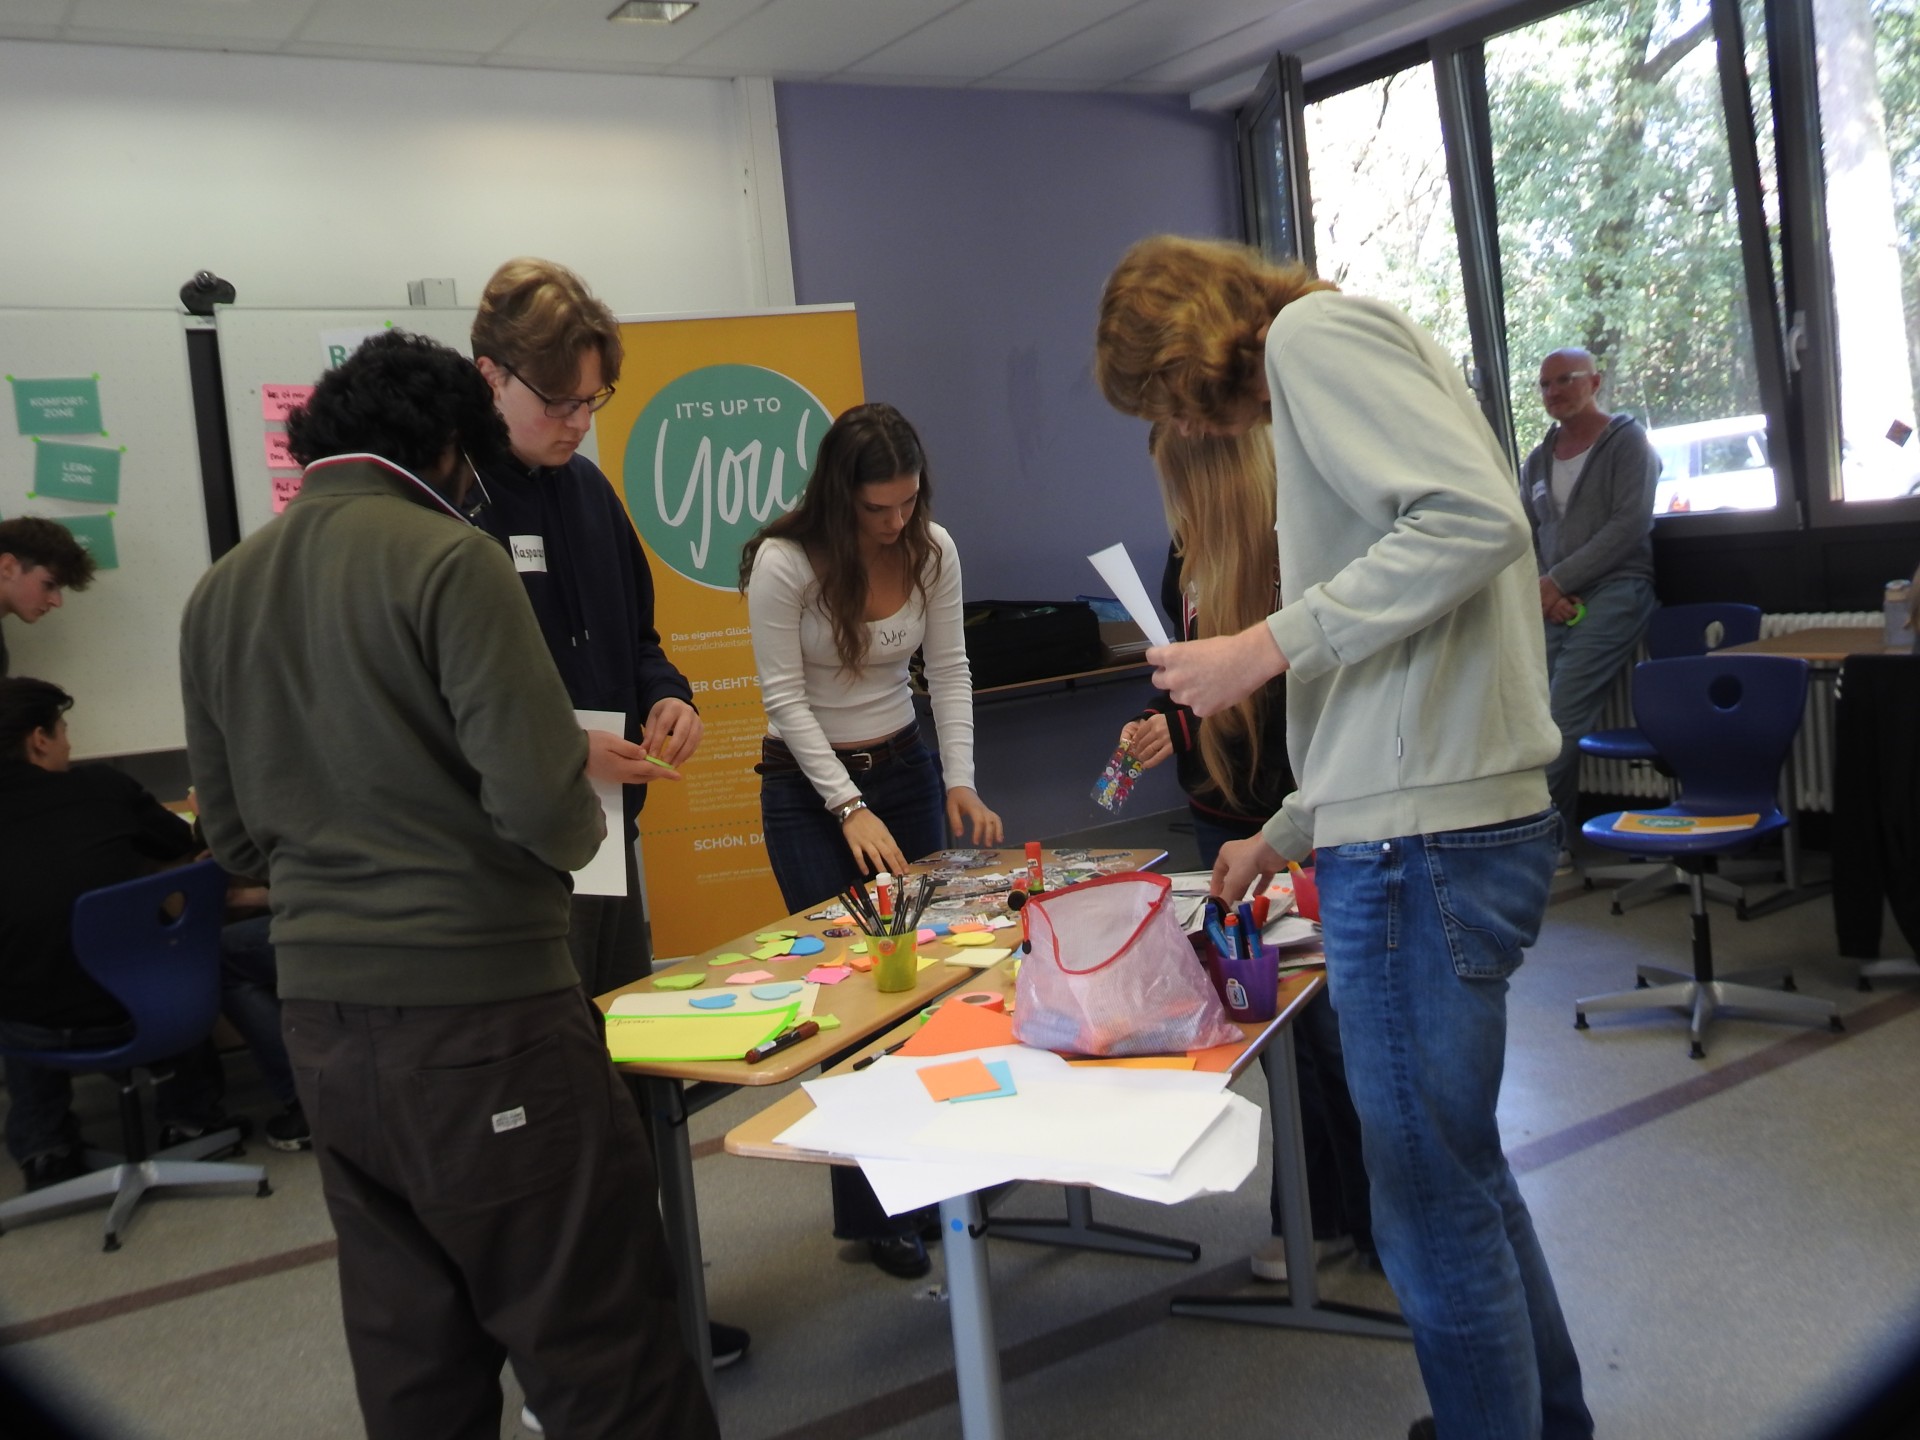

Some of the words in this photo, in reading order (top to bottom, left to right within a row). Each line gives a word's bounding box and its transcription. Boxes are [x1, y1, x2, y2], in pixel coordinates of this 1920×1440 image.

[29, 396, 88, 408] KOMFORT-
[676, 402, 713, 419] IT'S
[720, 399, 749, 416] UP
[753, 397, 781, 413] TO
[43, 407, 75, 418] ZONE
[62, 462, 96, 474] LERN-
[61, 473, 93, 485] ZONE
[671, 632, 689, 642] Das
[691, 630, 724, 641] eigene
[672, 638, 753, 653] Persönlichkeitsen
[691, 681, 710, 693] ER
[694, 834, 747, 851] SCHÖN,
[749, 834, 766, 846] DA
